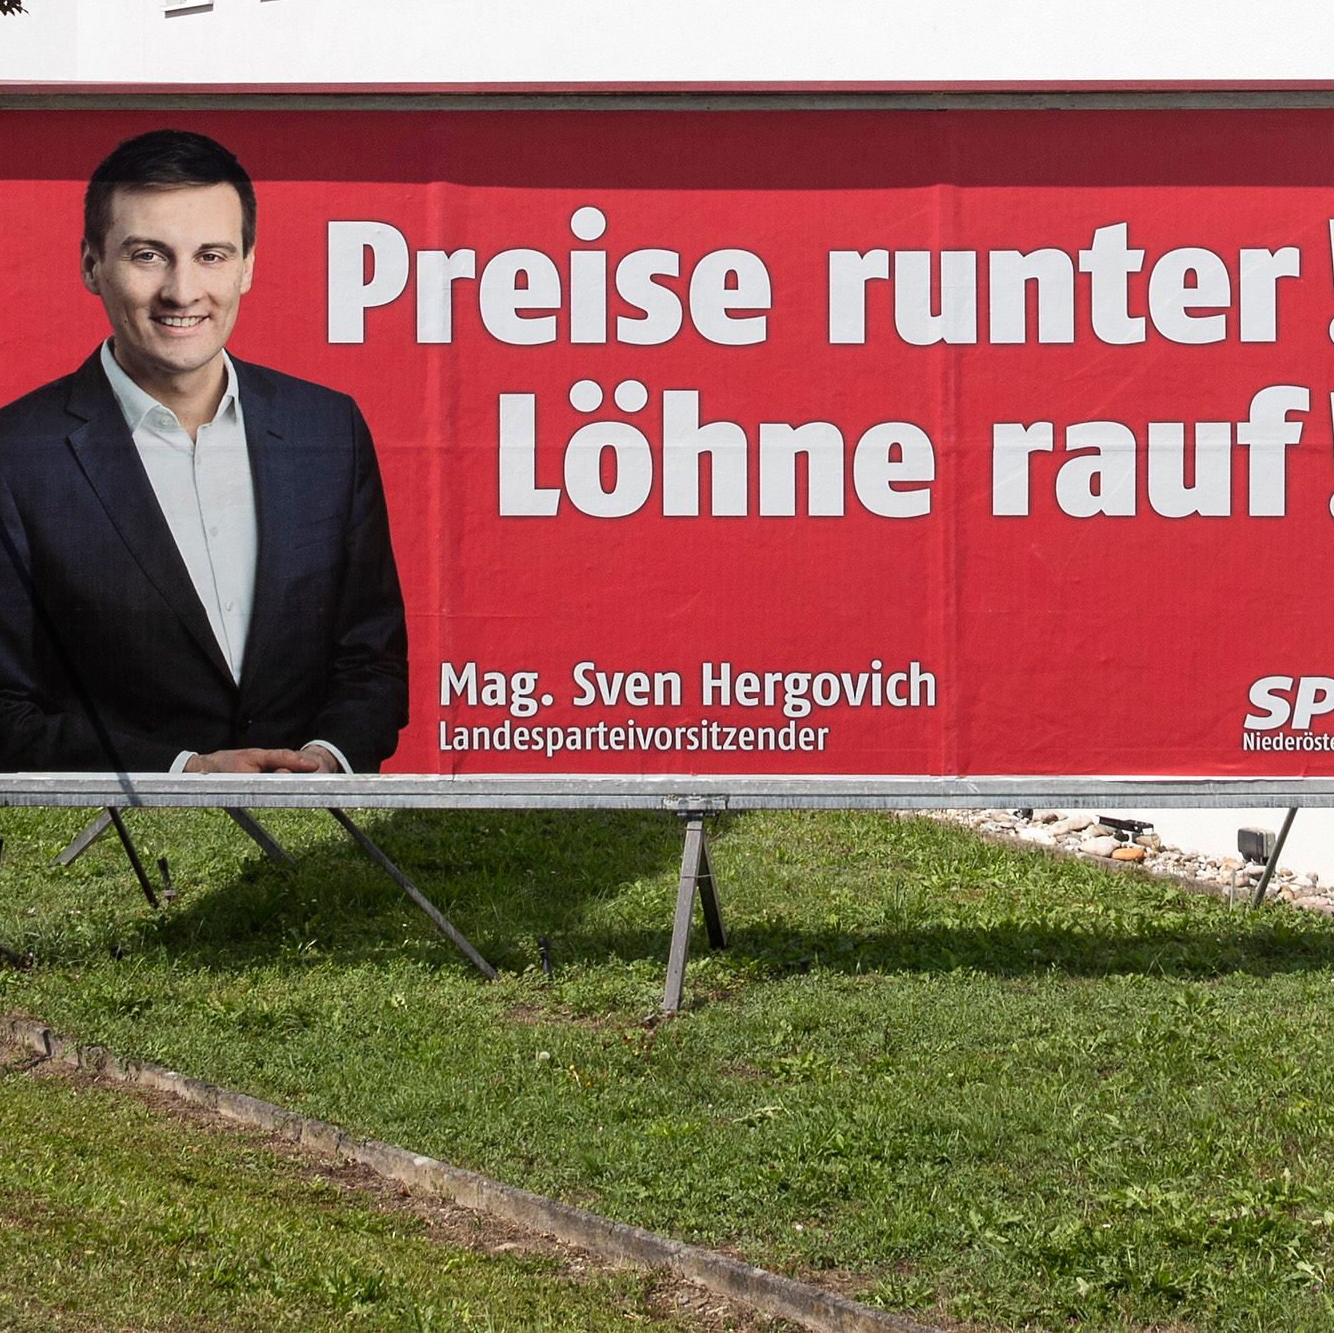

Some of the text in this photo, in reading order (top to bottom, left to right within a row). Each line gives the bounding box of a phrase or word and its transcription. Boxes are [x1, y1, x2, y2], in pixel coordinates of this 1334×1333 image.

[327, 206, 772, 346] Preise
[499, 379, 935, 518] Löhne
[440, 659, 936, 717] Mag. Sven Hergovich
[439, 719, 829, 756] Landesparteivorsitzender
